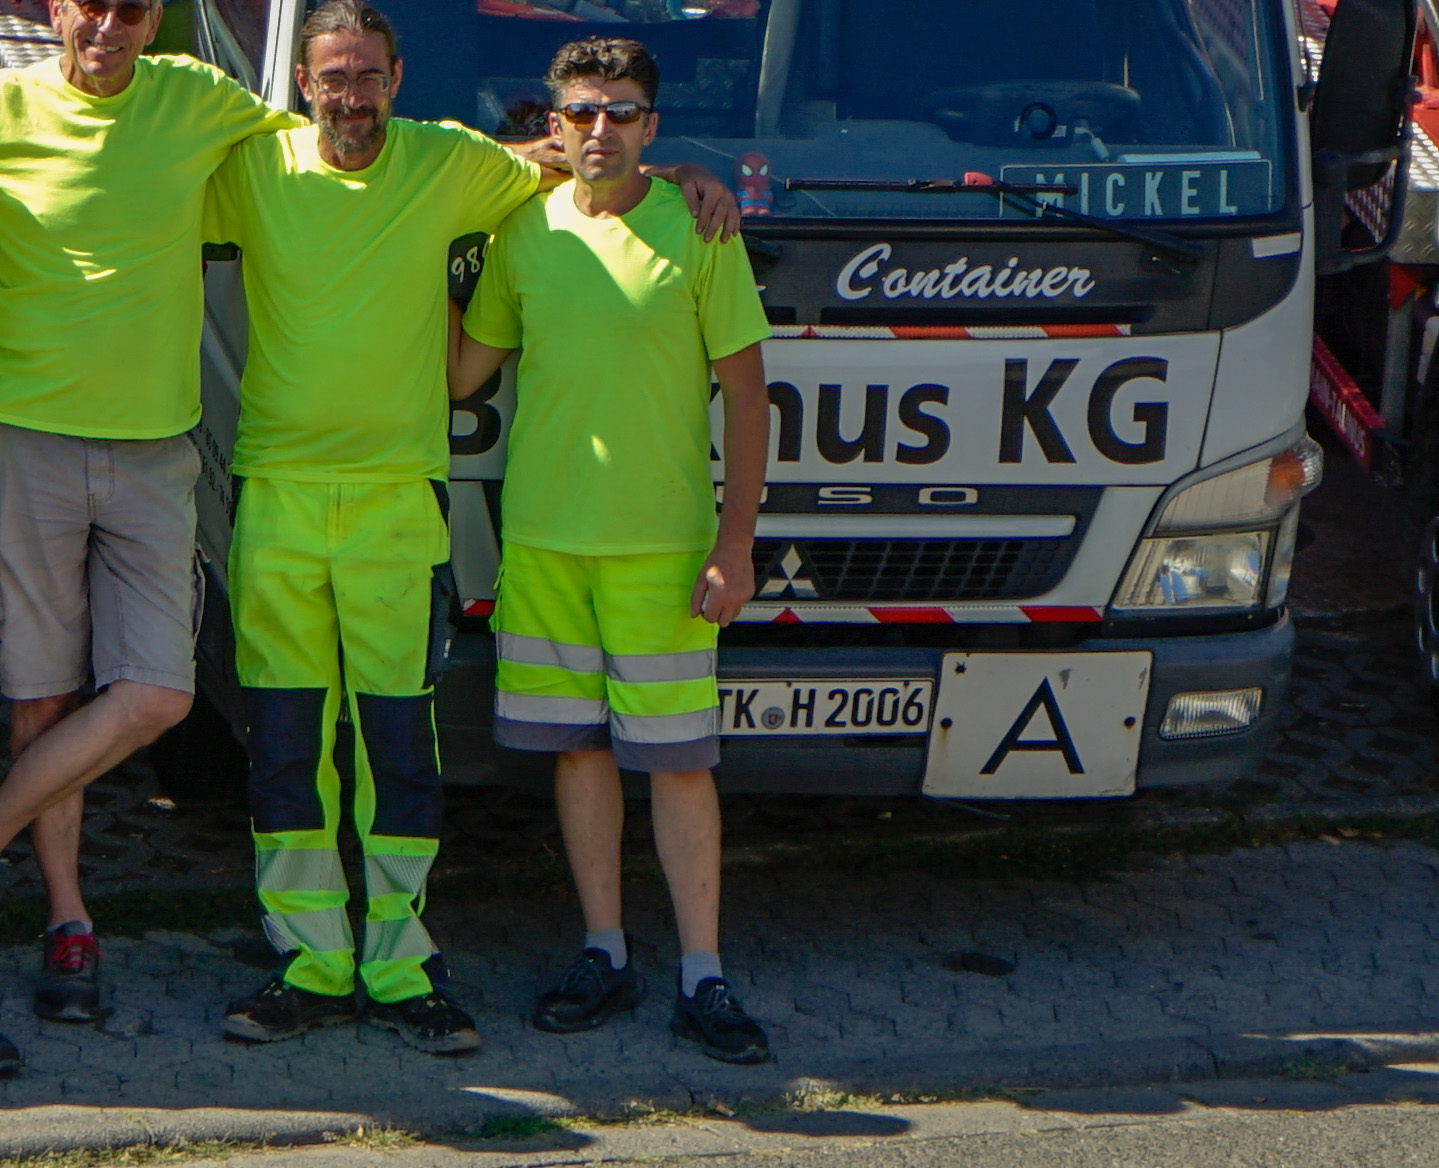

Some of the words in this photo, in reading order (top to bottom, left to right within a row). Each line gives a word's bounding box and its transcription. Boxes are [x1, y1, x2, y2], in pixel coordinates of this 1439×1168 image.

[1036, 169, 1239, 218] MICKEL
[836, 243, 1096, 300] Container
[999, 357, 1168, 465] KG
[718, 689, 760, 728] TK
[790, 689, 816, 727] H
[824, 688, 924, 727] 2006
[978, 675, 1085, 775] A
